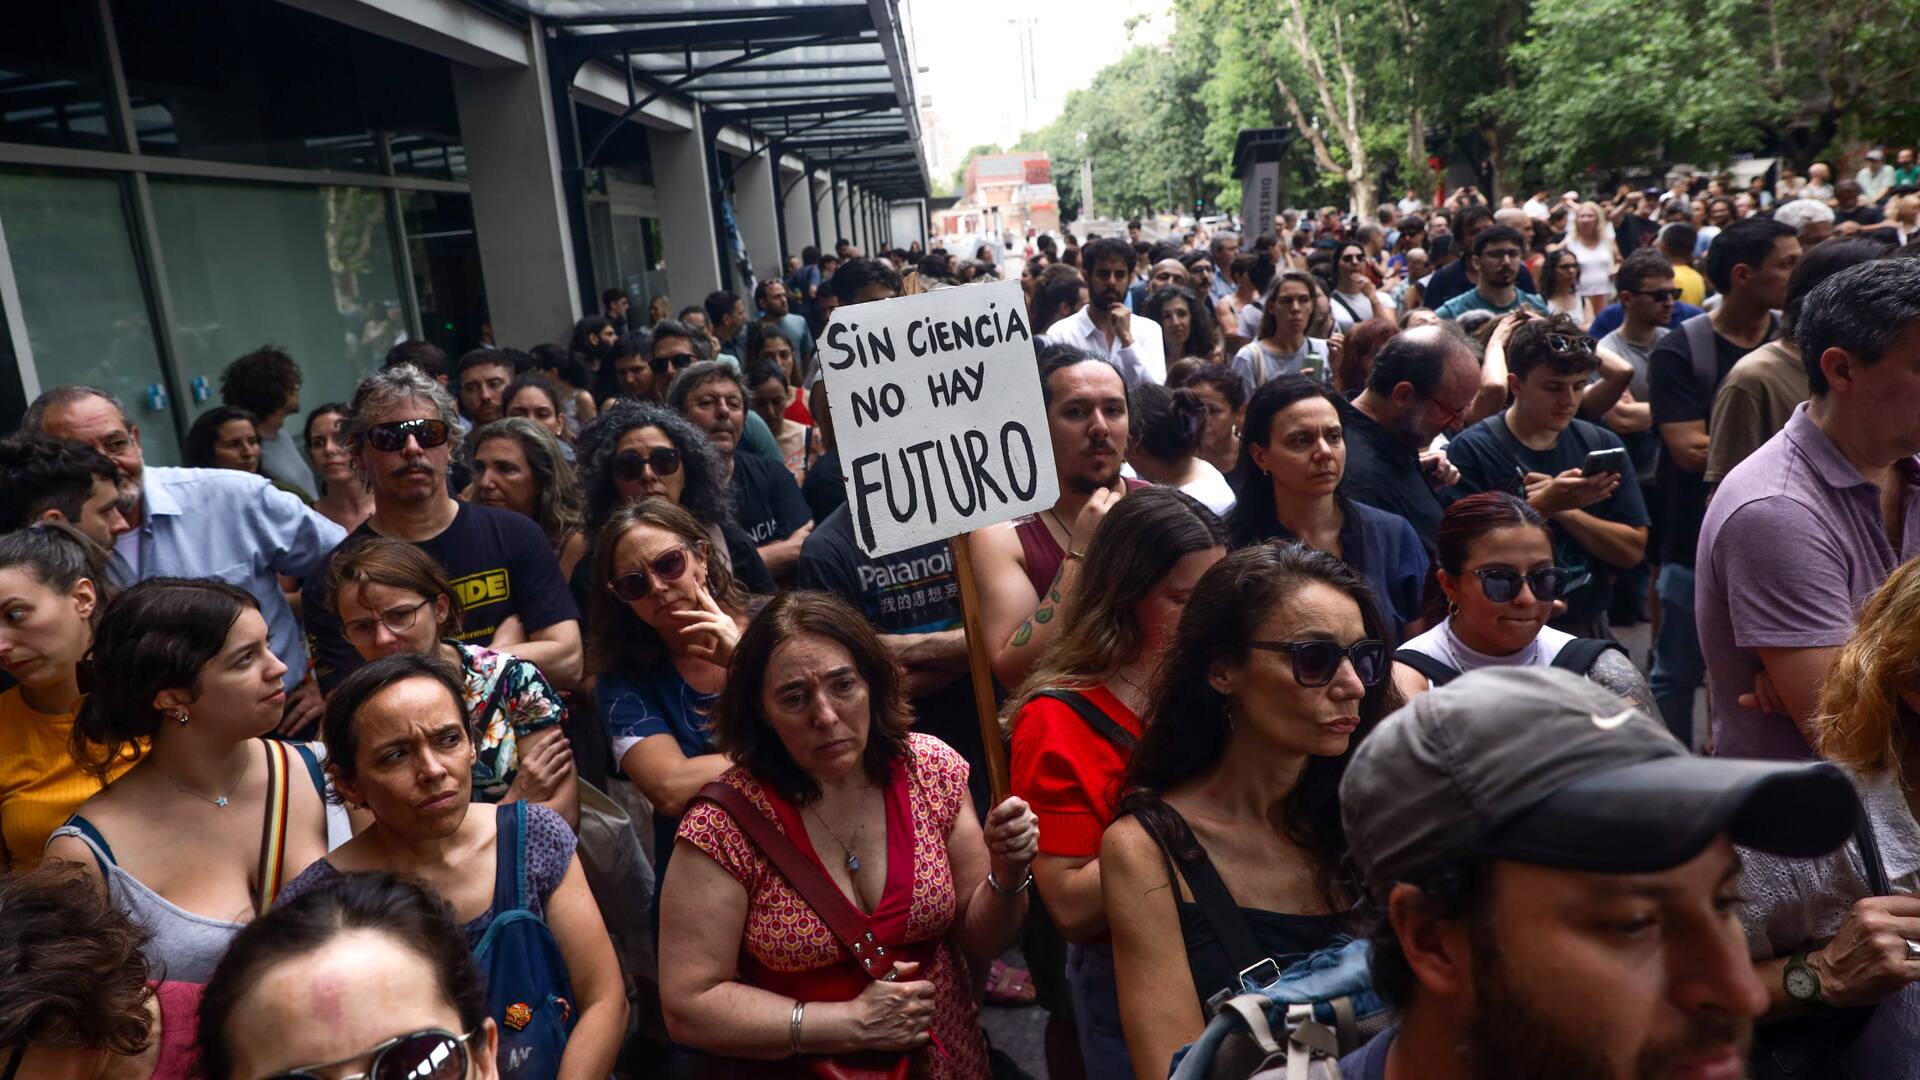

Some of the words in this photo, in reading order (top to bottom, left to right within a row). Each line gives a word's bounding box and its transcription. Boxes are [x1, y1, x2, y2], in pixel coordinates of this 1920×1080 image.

[850, 383, 905, 427] NO
[927, 361, 984, 408] HAY
[852, 421, 1038, 554] FUTURO
